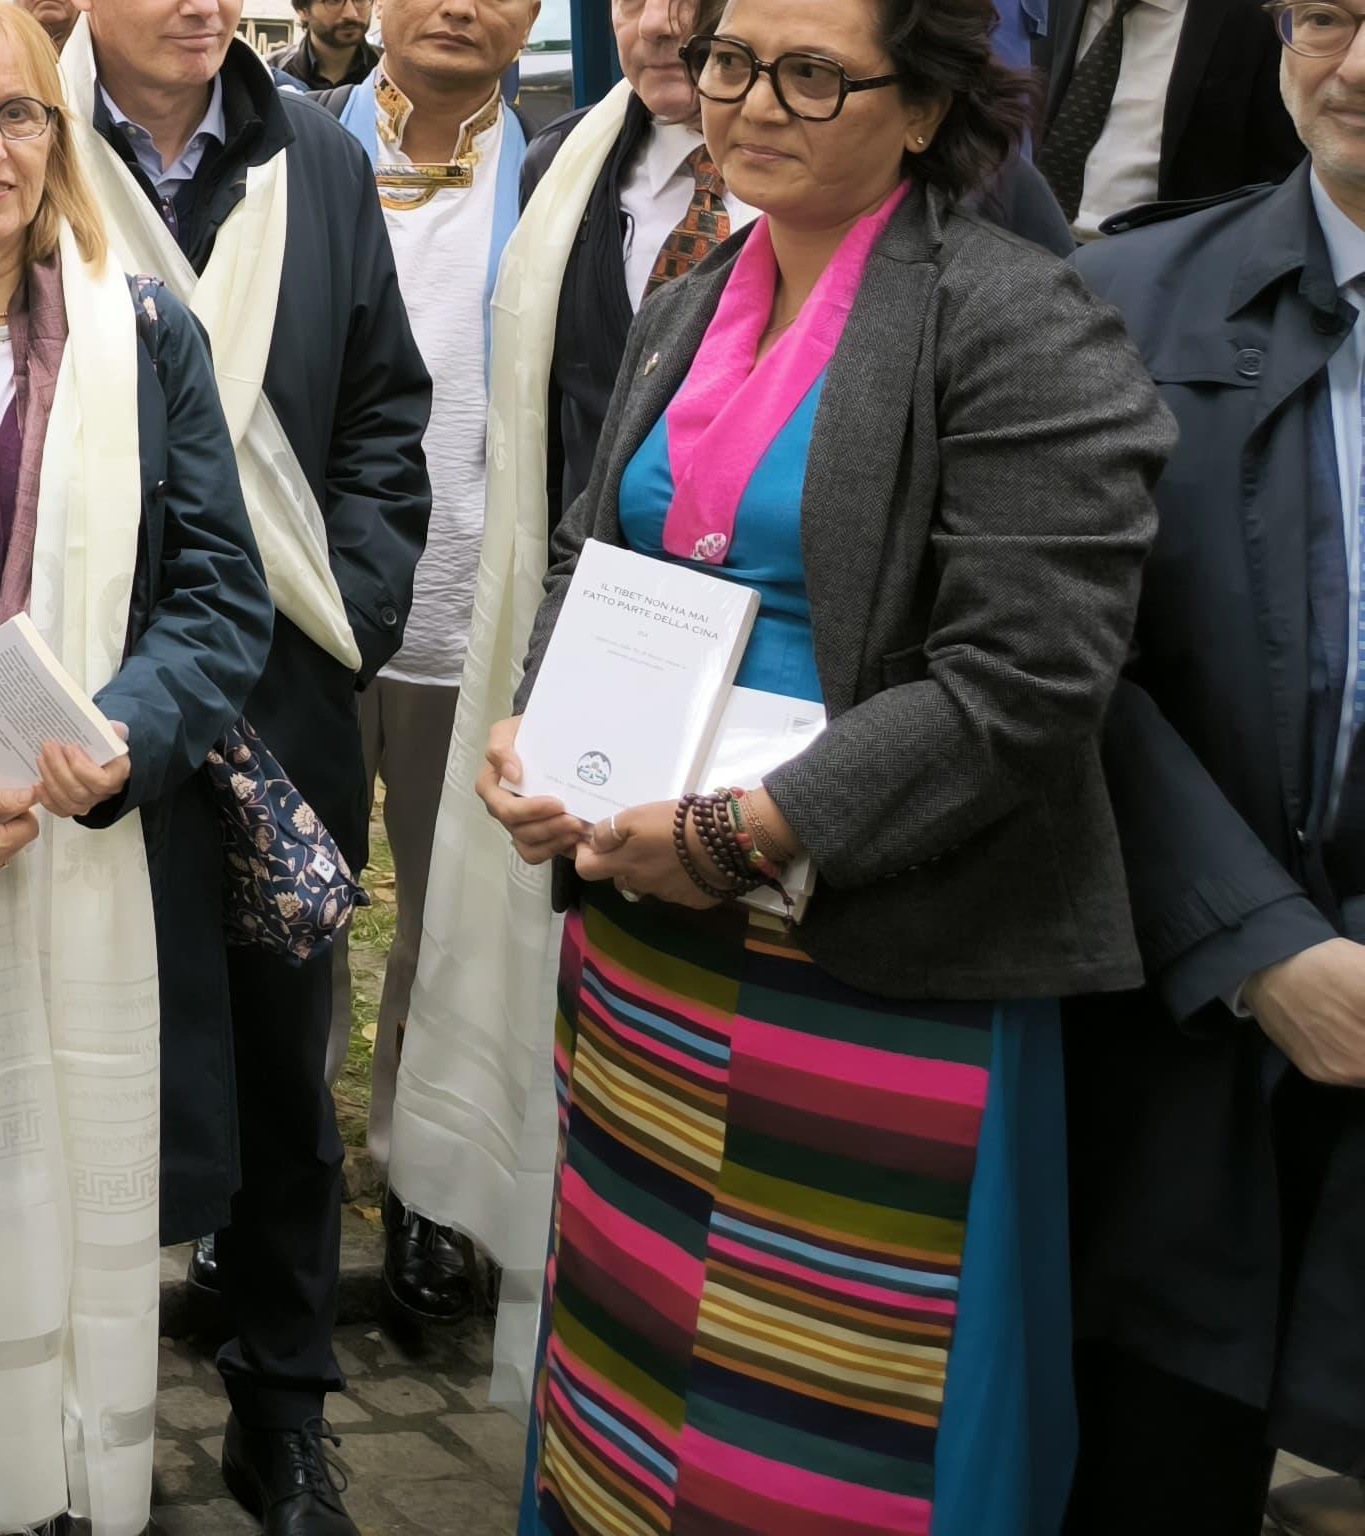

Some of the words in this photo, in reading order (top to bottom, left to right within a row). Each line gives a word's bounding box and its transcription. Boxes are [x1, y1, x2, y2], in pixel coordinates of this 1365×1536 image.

[582, 589, 616, 606] FATTO
[617, 601, 653, 618] PARTE
[653, 612, 690, 631] DELLA
[691, 625, 720, 641] CINA
[600, 582, 610, 592] IL
[613, 584, 644, 601] TIBET
[645, 596, 670, 610] NON
[670, 605, 686, 616] HA
[688, 611, 710, 624] MAI
